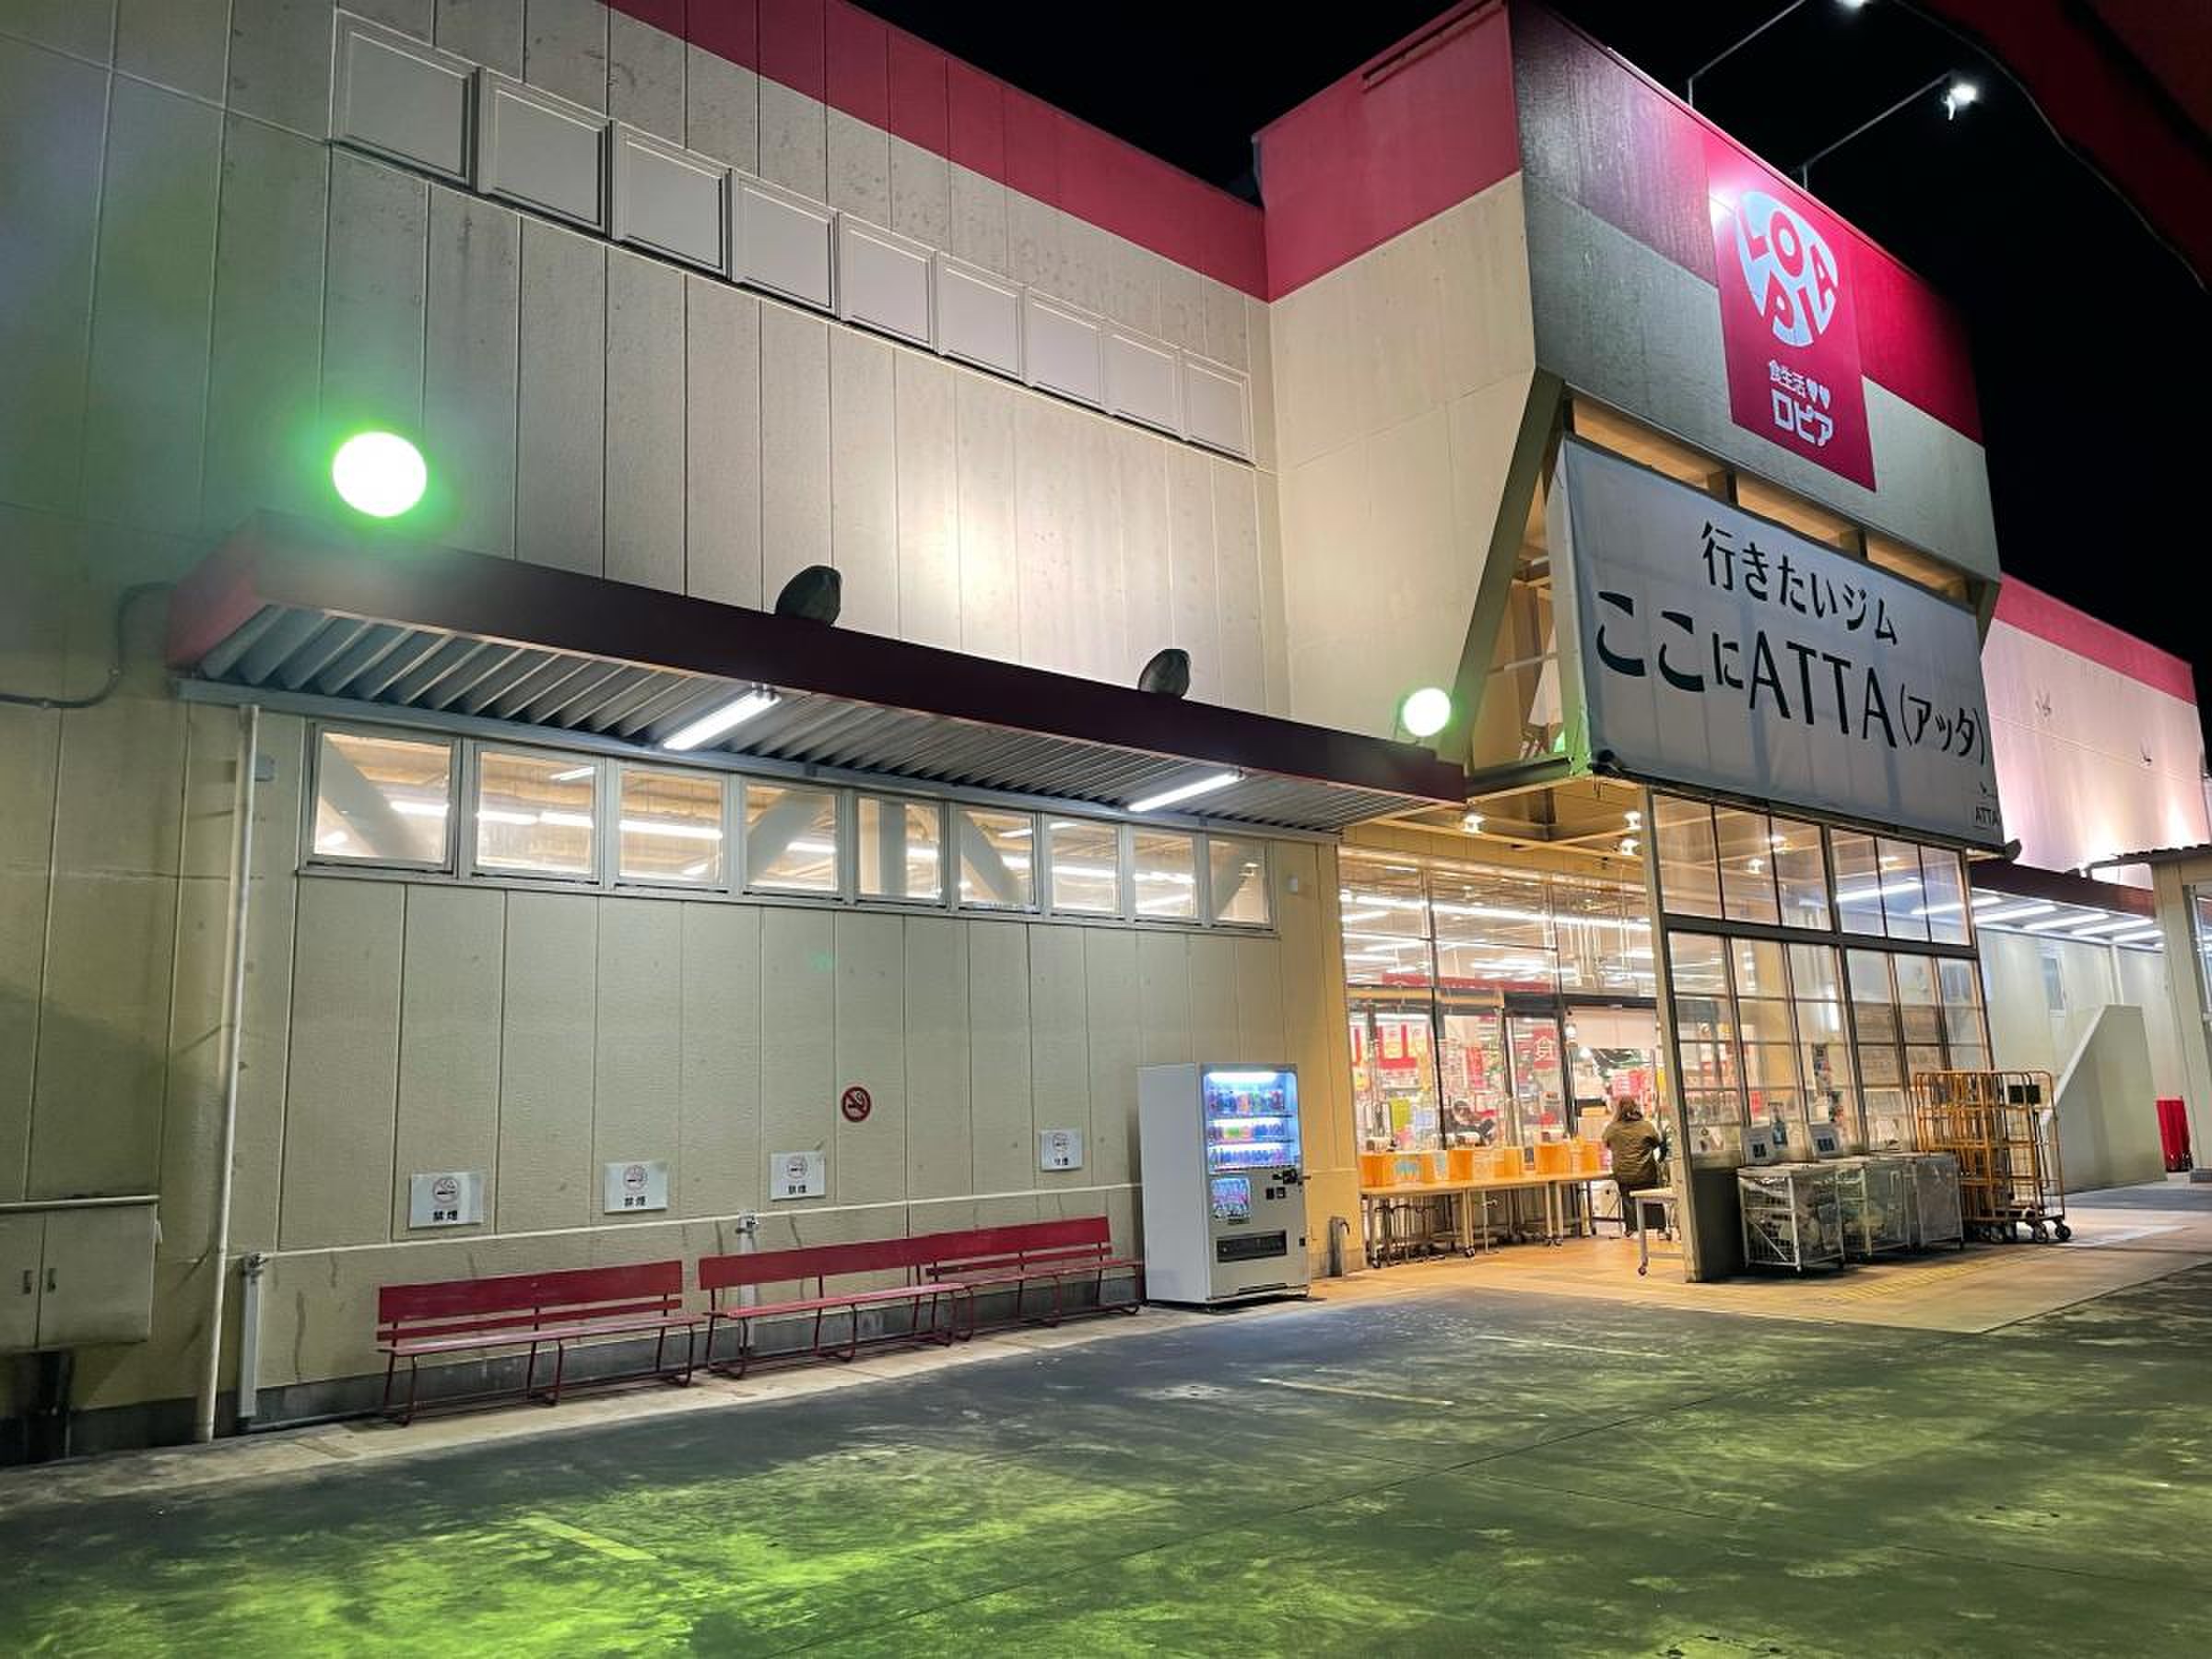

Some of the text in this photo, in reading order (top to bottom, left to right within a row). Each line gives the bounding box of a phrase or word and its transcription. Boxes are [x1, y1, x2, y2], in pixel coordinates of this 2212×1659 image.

[1771, 388, 1833, 446] ロピア
[1701, 521, 1898, 645] 行きたいジム
